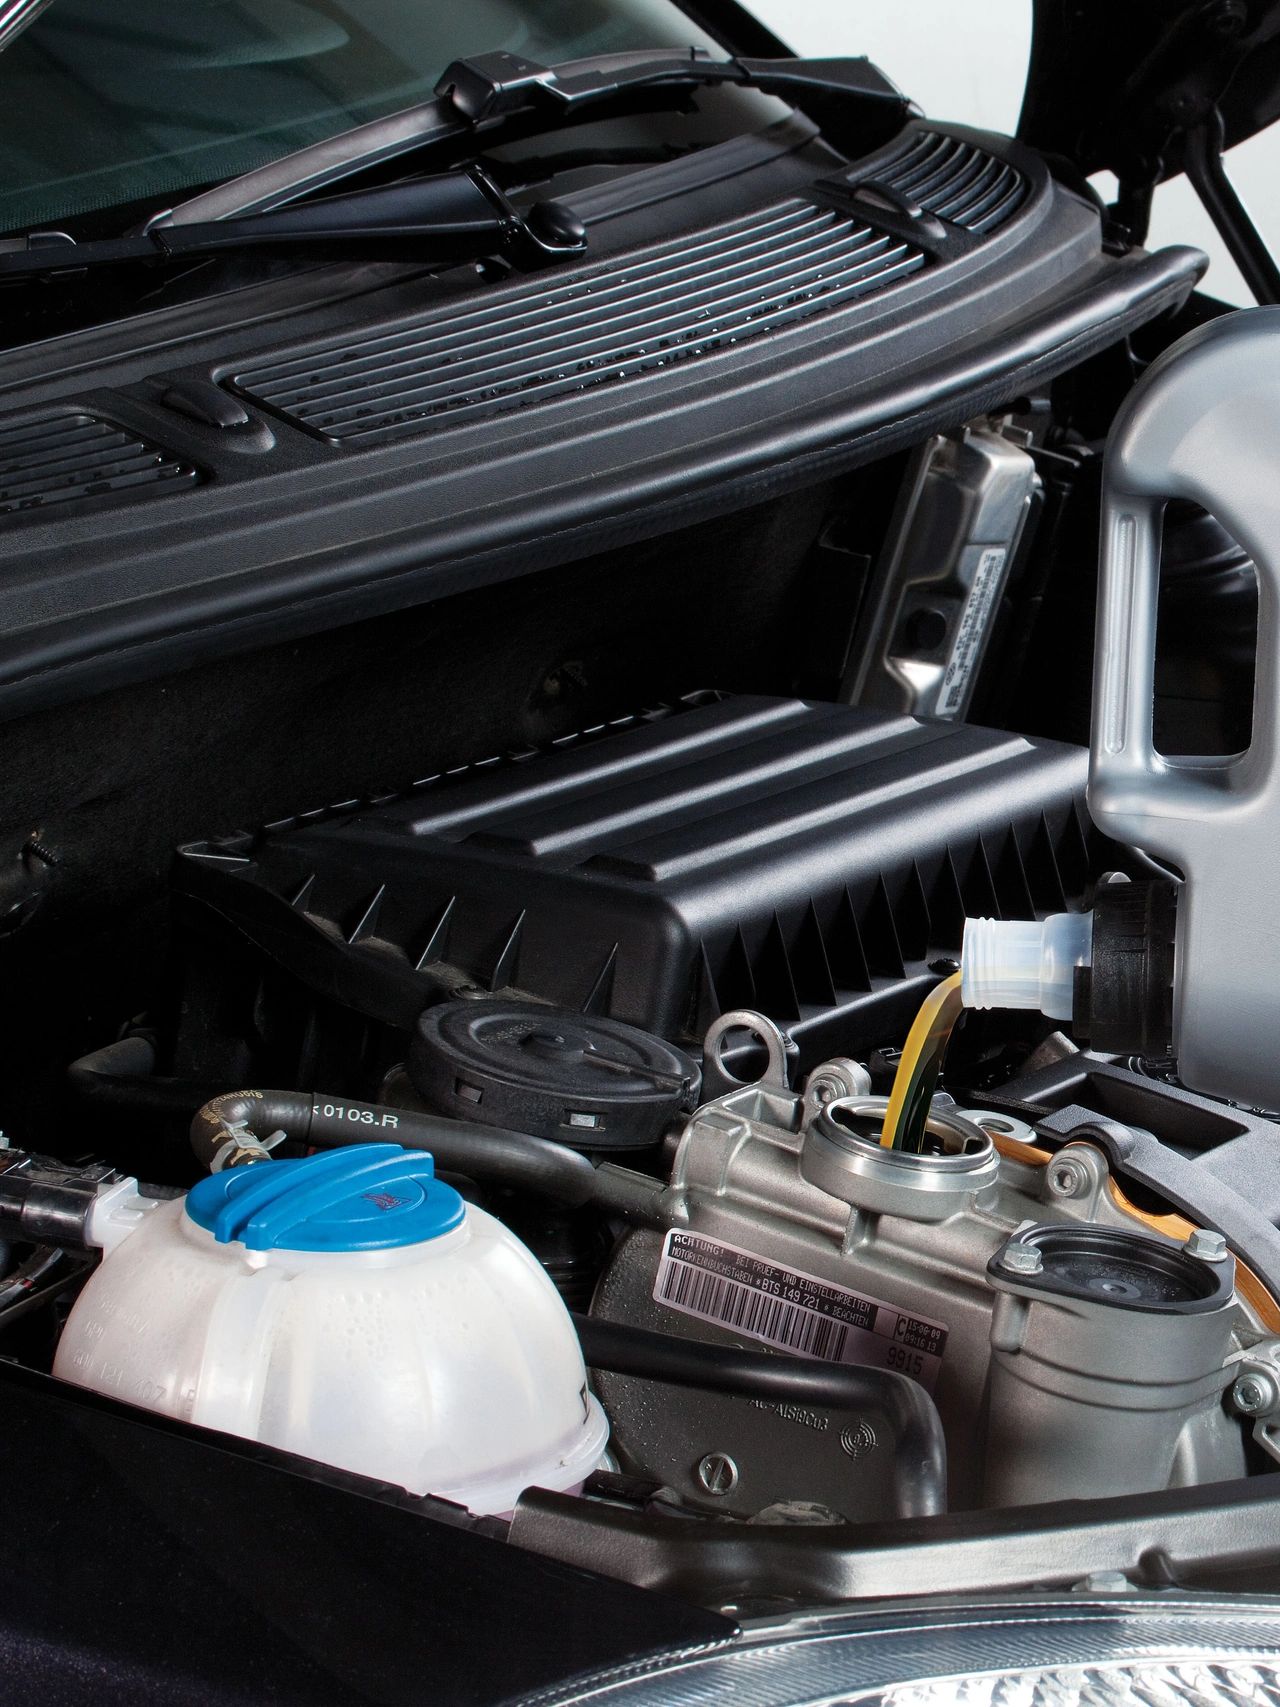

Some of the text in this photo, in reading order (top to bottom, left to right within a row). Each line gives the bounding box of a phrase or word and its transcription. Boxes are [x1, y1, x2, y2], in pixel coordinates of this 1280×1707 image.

[674, 1234, 724, 1257] ACHTUNG!
[782, 1271, 796, 1284] UND
[782, 1288, 799, 1302] 149
[802, 1293, 820, 1310] 721
[887, 1346, 923, 1374] 9915
